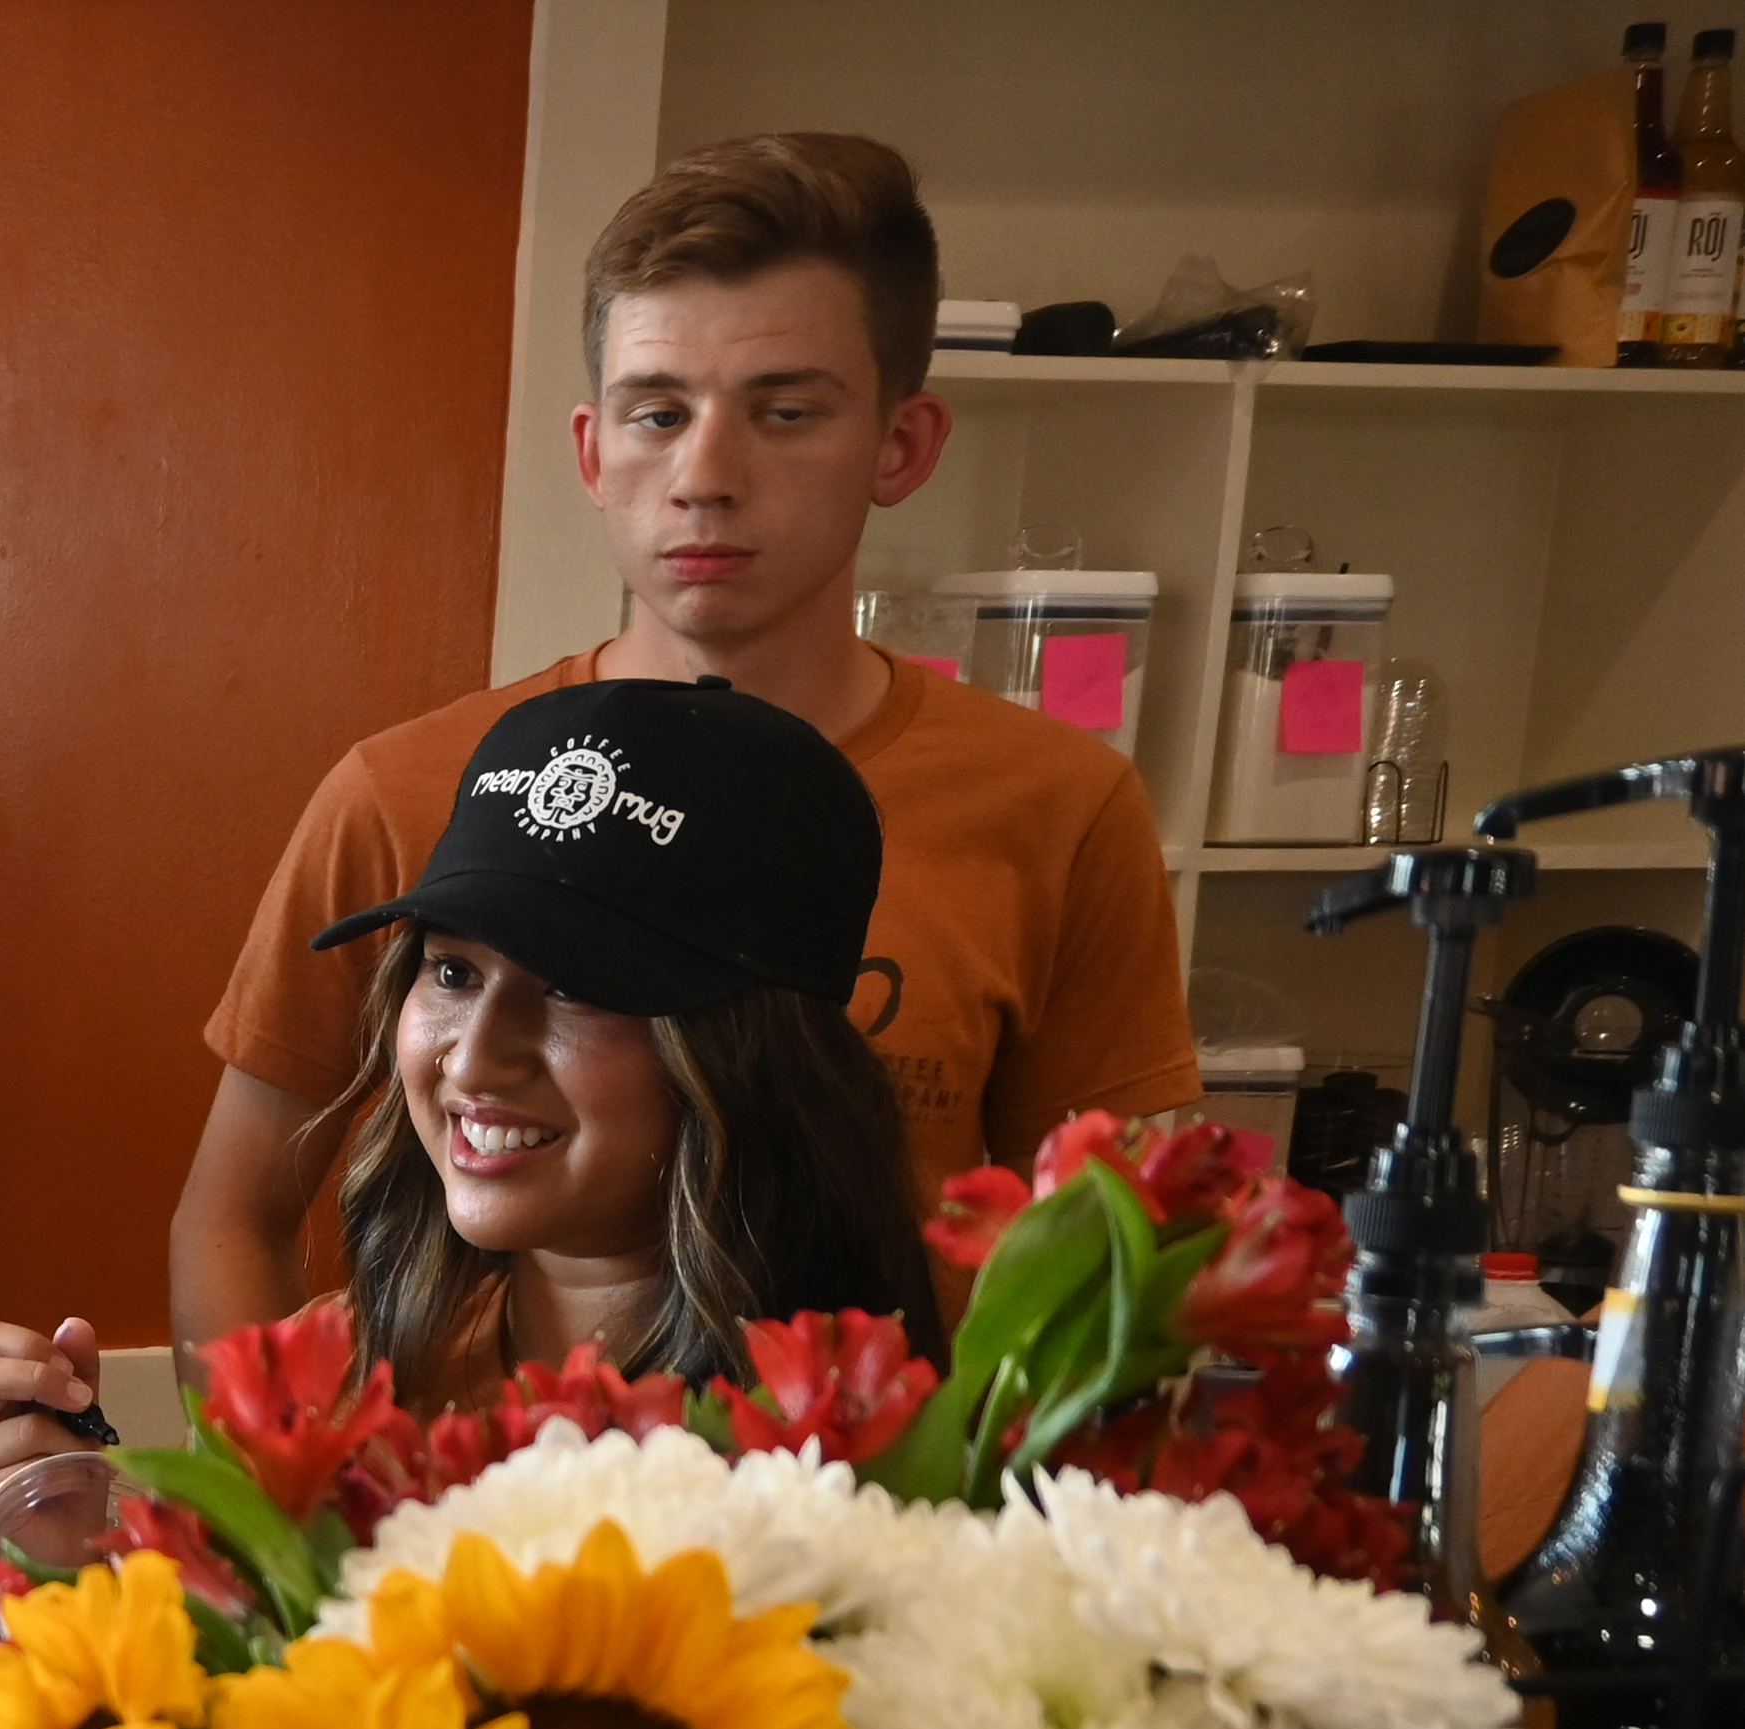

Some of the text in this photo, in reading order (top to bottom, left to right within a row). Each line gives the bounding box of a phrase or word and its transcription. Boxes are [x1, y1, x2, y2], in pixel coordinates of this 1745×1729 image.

[550, 734, 632, 773] COFFEE
[470, 768, 686, 846] mean mug
[513, 807, 597, 843] COMPANY
